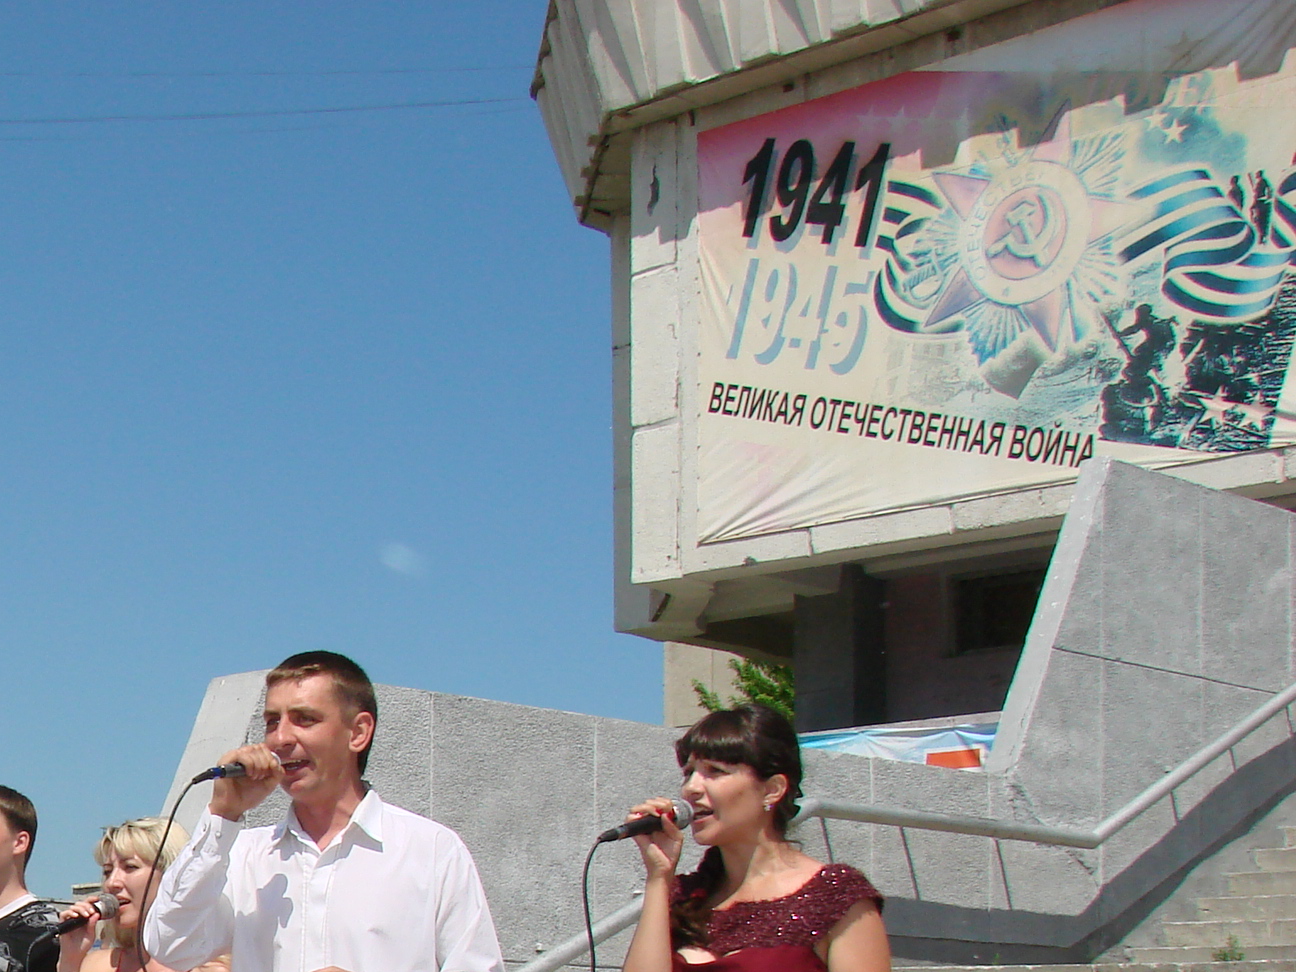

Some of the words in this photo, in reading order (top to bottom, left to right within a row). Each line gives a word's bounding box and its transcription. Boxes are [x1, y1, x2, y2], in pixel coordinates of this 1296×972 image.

[742, 137, 891, 248] 1941
[726, 258, 875, 375] 1945
[707, 381, 807, 427] ВЕЛИКАЯ
[809, 396, 1006, 457] ОТЕЧЕСТВЕННАЯ
[1007, 420, 1094, 468] ВОЙНА
